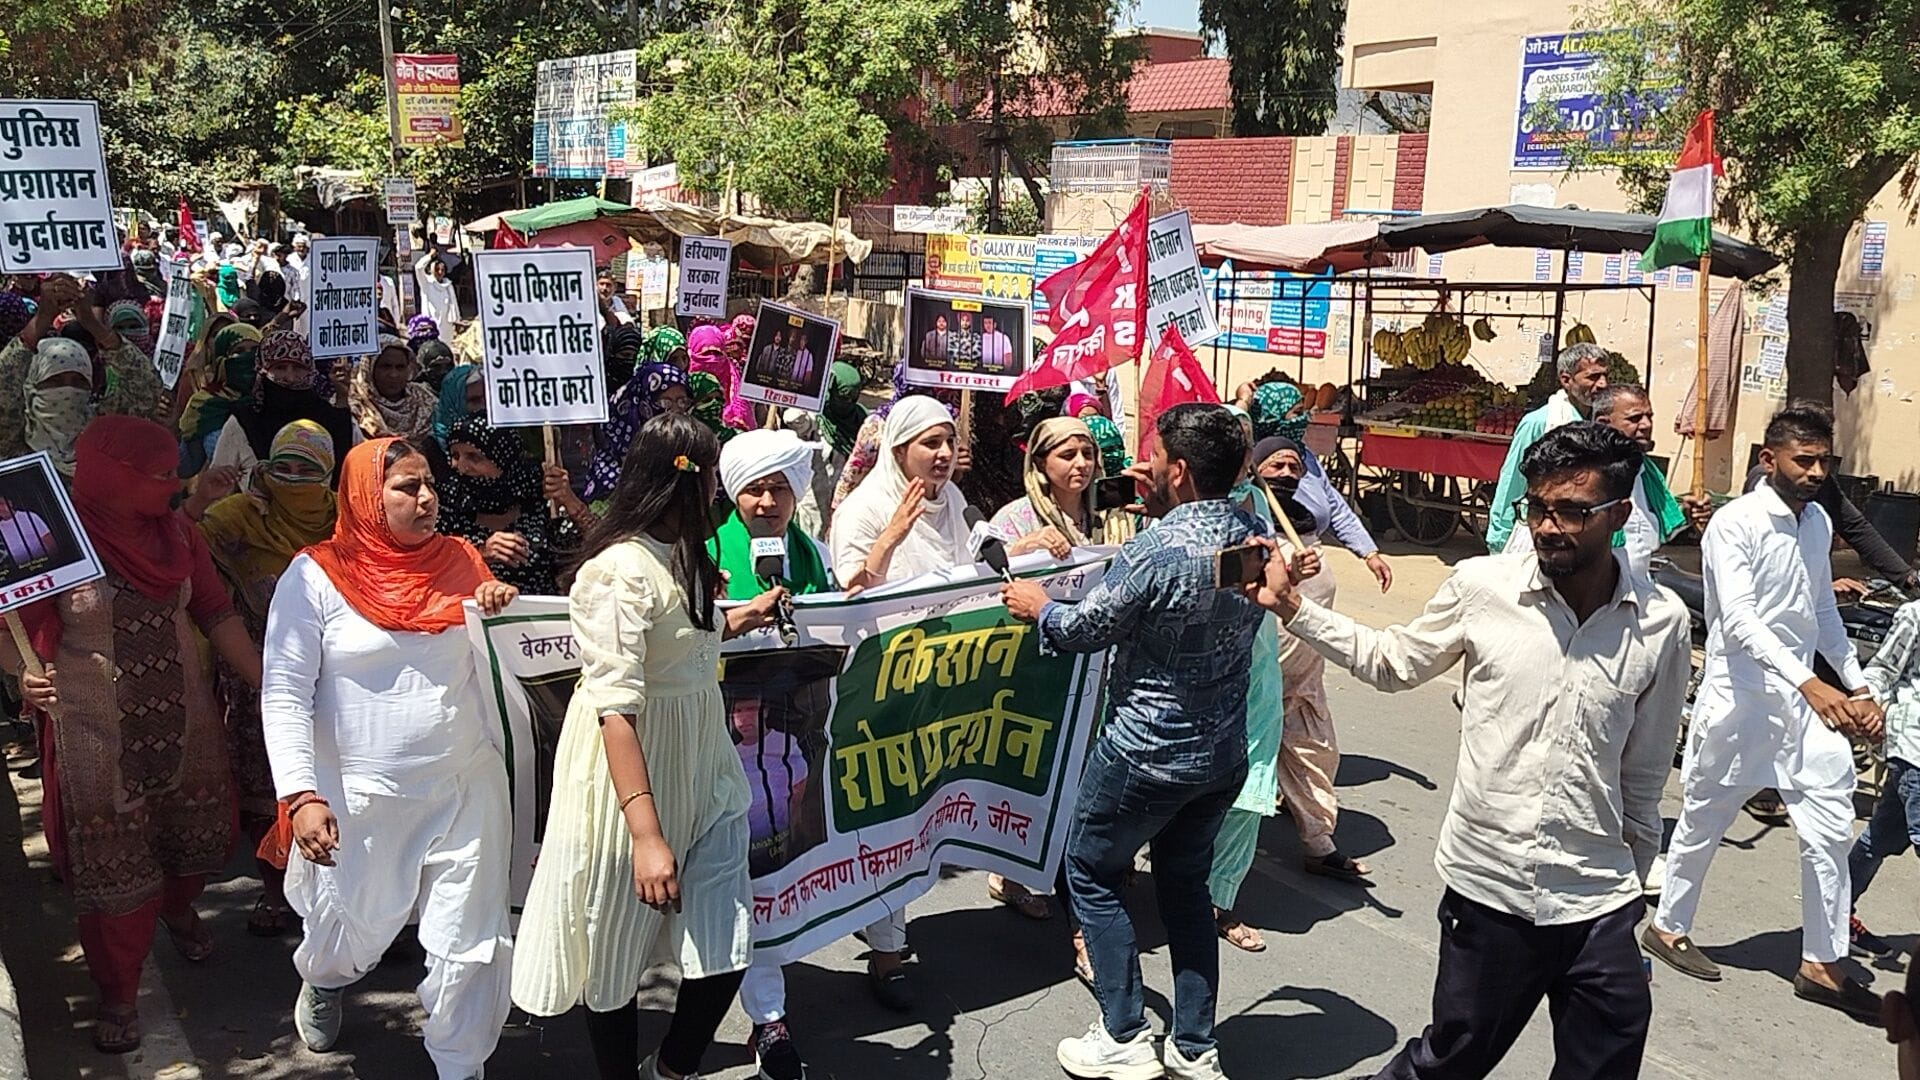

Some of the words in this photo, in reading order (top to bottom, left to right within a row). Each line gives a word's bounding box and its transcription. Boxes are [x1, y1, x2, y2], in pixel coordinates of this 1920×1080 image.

[1536, 72, 1570, 85] CLASSES
[0, 108, 81, 160] पुलिस
[0, 169, 97, 201] प्रशासन
[4, 210, 107, 264] मुर्दाबाद
[685, 241, 727, 261] हरियाणा
[984, 242, 1014, 257] GALAXY
[1016, 243, 1035, 258] AXIS
[1151, 227, 1184, 259] किसान
[320, 251, 337, 282] युवा
[339, 244, 367, 272] किसान
[687, 268, 720, 284] सरकार
[315, 282, 342, 311] अनीश
[342, 286, 372, 314] खटकड़
[488, 273, 523, 316] युवा
[523, 263, 583, 303] किसान
[1219, 303, 1263, 323] raining
[319, 318, 332, 347] को
[333, 318, 351, 347] रिहा
[352, 316, 368, 345] करो
[488, 316, 557, 368] गुरकिरत
[559, 312, 593, 353] सिंह
[497, 367, 521, 408] को
[523, 368, 558, 407] रिहा
[560, 365, 594, 405] करो
[11, 574, 55, 598] करो
[1057, 574, 1086, 590] करो
[519, 632, 581, 660] बेकसू
[874, 625, 1032, 702] किसान
[836, 719, 919, 812] रोष
[917, 688, 1053, 790] प्रदर्शन
[778, 883, 800, 917] जन
[797, 858, 855, 904] कल्याण
[987, 800, 1033, 846] जीन्द
